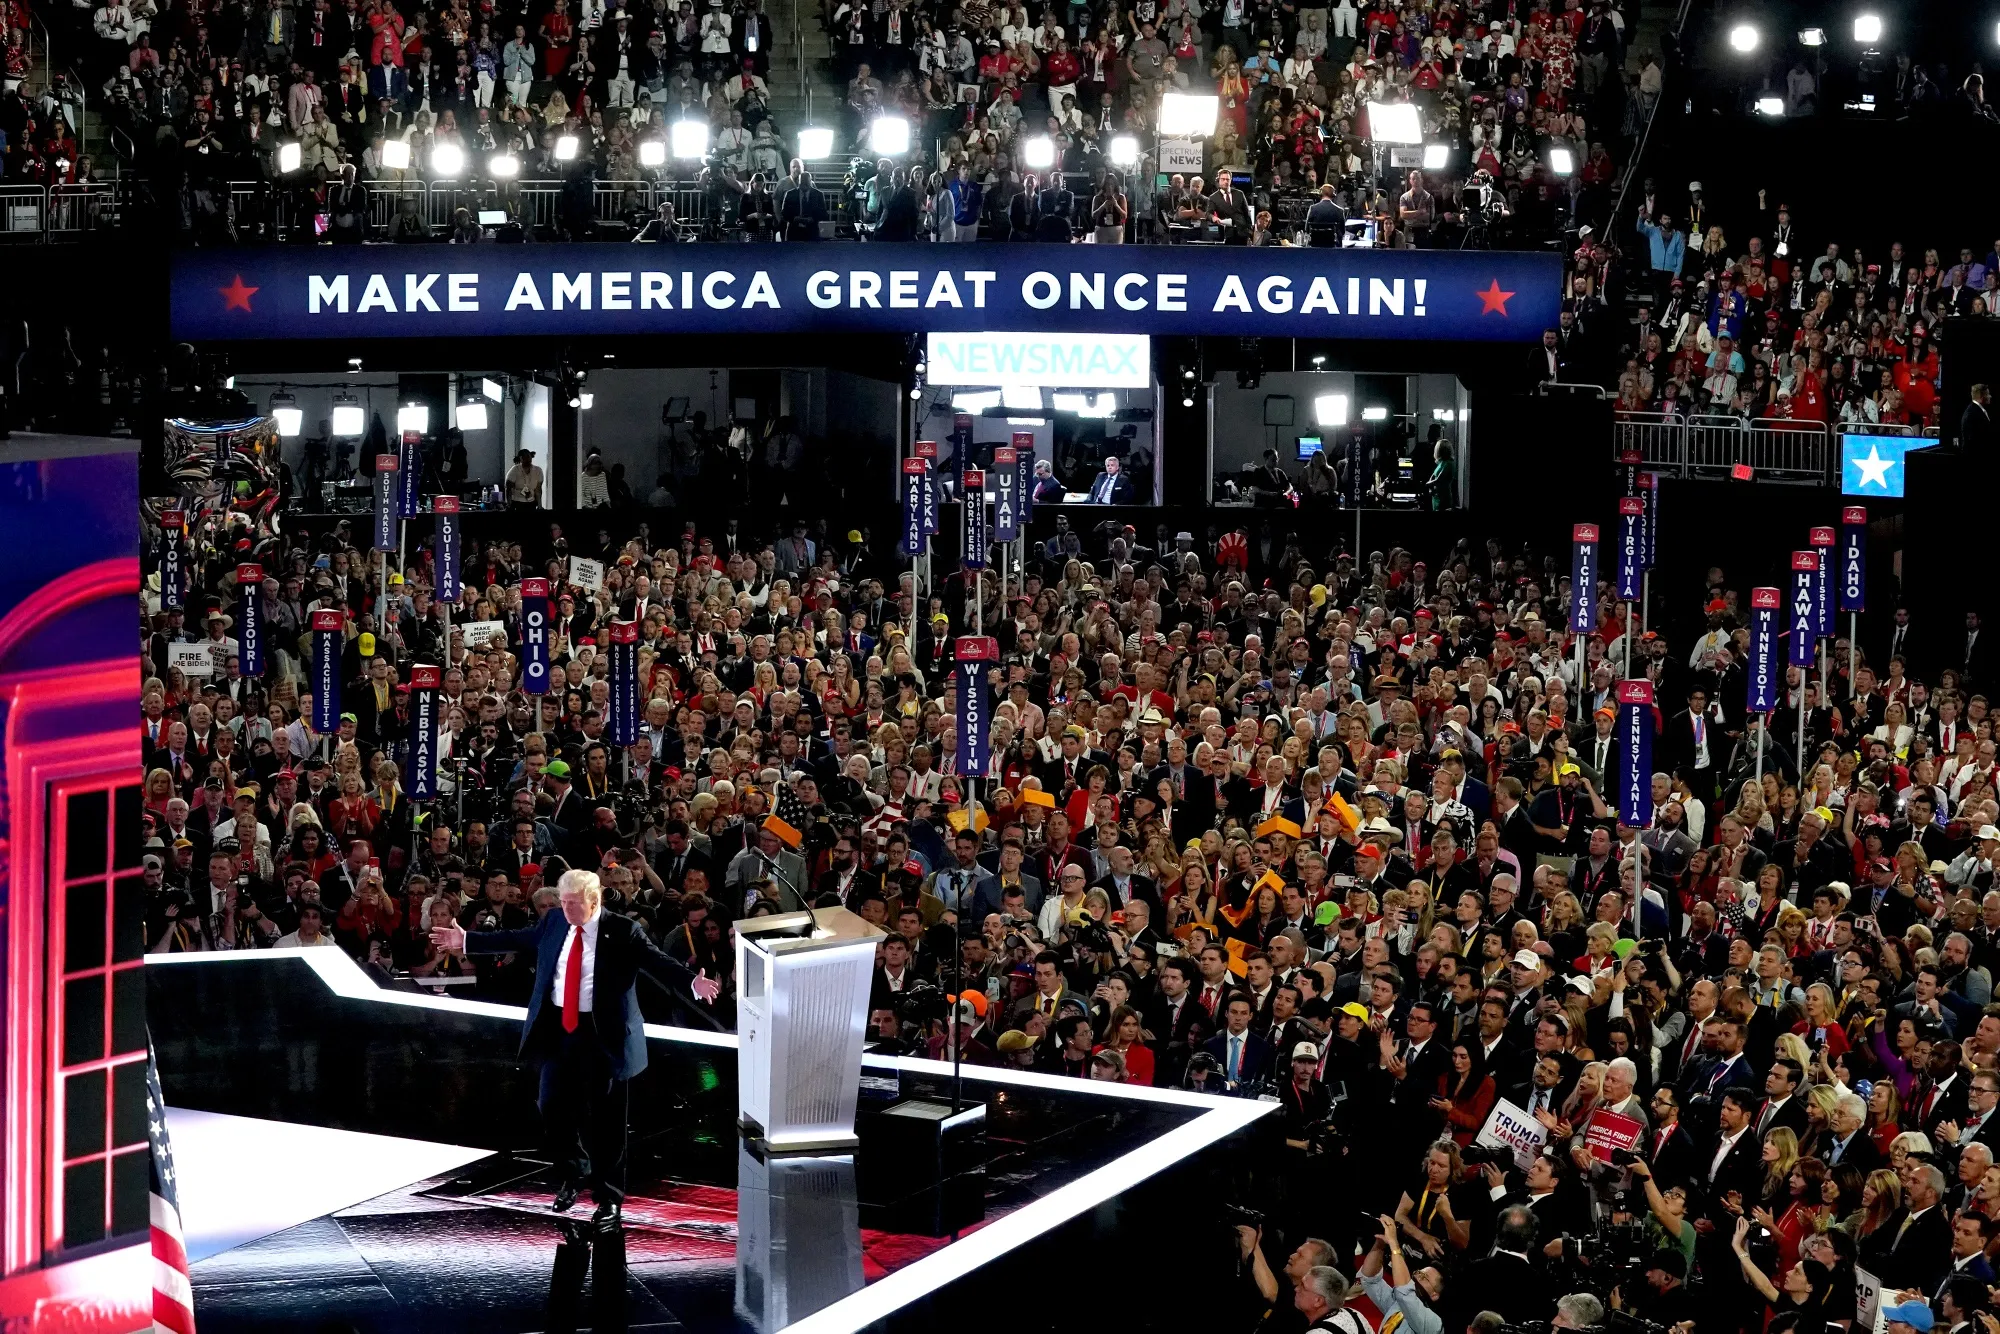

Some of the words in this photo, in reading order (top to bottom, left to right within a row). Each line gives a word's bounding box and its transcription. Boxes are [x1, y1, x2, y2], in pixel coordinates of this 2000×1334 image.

[1170, 156, 1202, 165] NEWS
[308, 273, 479, 314] MAKE
[504, 270, 781, 311] AMERICA
[806, 270, 996, 309] GREAT
[1021, 271, 1188, 312] ONCE
[1212, 274, 1427, 317] AGAIN!
[937, 342, 1138, 374] NEWSMAX
[382, 472, 390, 505] SOUTH
[924, 458, 934, 528] ALASKA
[999, 474, 1012, 529] UTAH
[1019, 461, 1027, 516] COLUMBIA
[1354, 436, 1362, 500] WASHINGTON
[381, 507, 389, 546] DAKOTA
[909, 475, 919, 550] MARYLAND
[967, 492, 975, 561] NORTHERN
[166, 530, 179, 605] WYOMING
[442, 516, 453, 598] LOUISIANA
[1577, 546, 1591, 627] MICHIGAN
[1623, 515, 1636, 596] VIRGINIA
[1818, 548, 1827, 631] MISSISSIPPI
[1846, 535, 1860, 597] IDAHO
[245, 585, 256, 671] MISSOURI
[527, 611, 544, 678] OHIO
[1794, 574, 1813, 659] HAWAII
[323, 632, 331, 728] MASSACHUSETTS
[1755, 611, 1771, 705] MINNESOTA
[415, 692, 431, 793] NEBRASKA
[964, 664, 980, 769] WISCONSIN
[1630, 706, 1640, 821] PENNSYLVANIA
[1494, 1124, 1530, 1153] VANCE
[1495, 1111, 1541, 1144] TRUMP
[1589, 1124, 1612, 1137] AMERICA
[1612, 1131, 1633, 1143] FIRST
